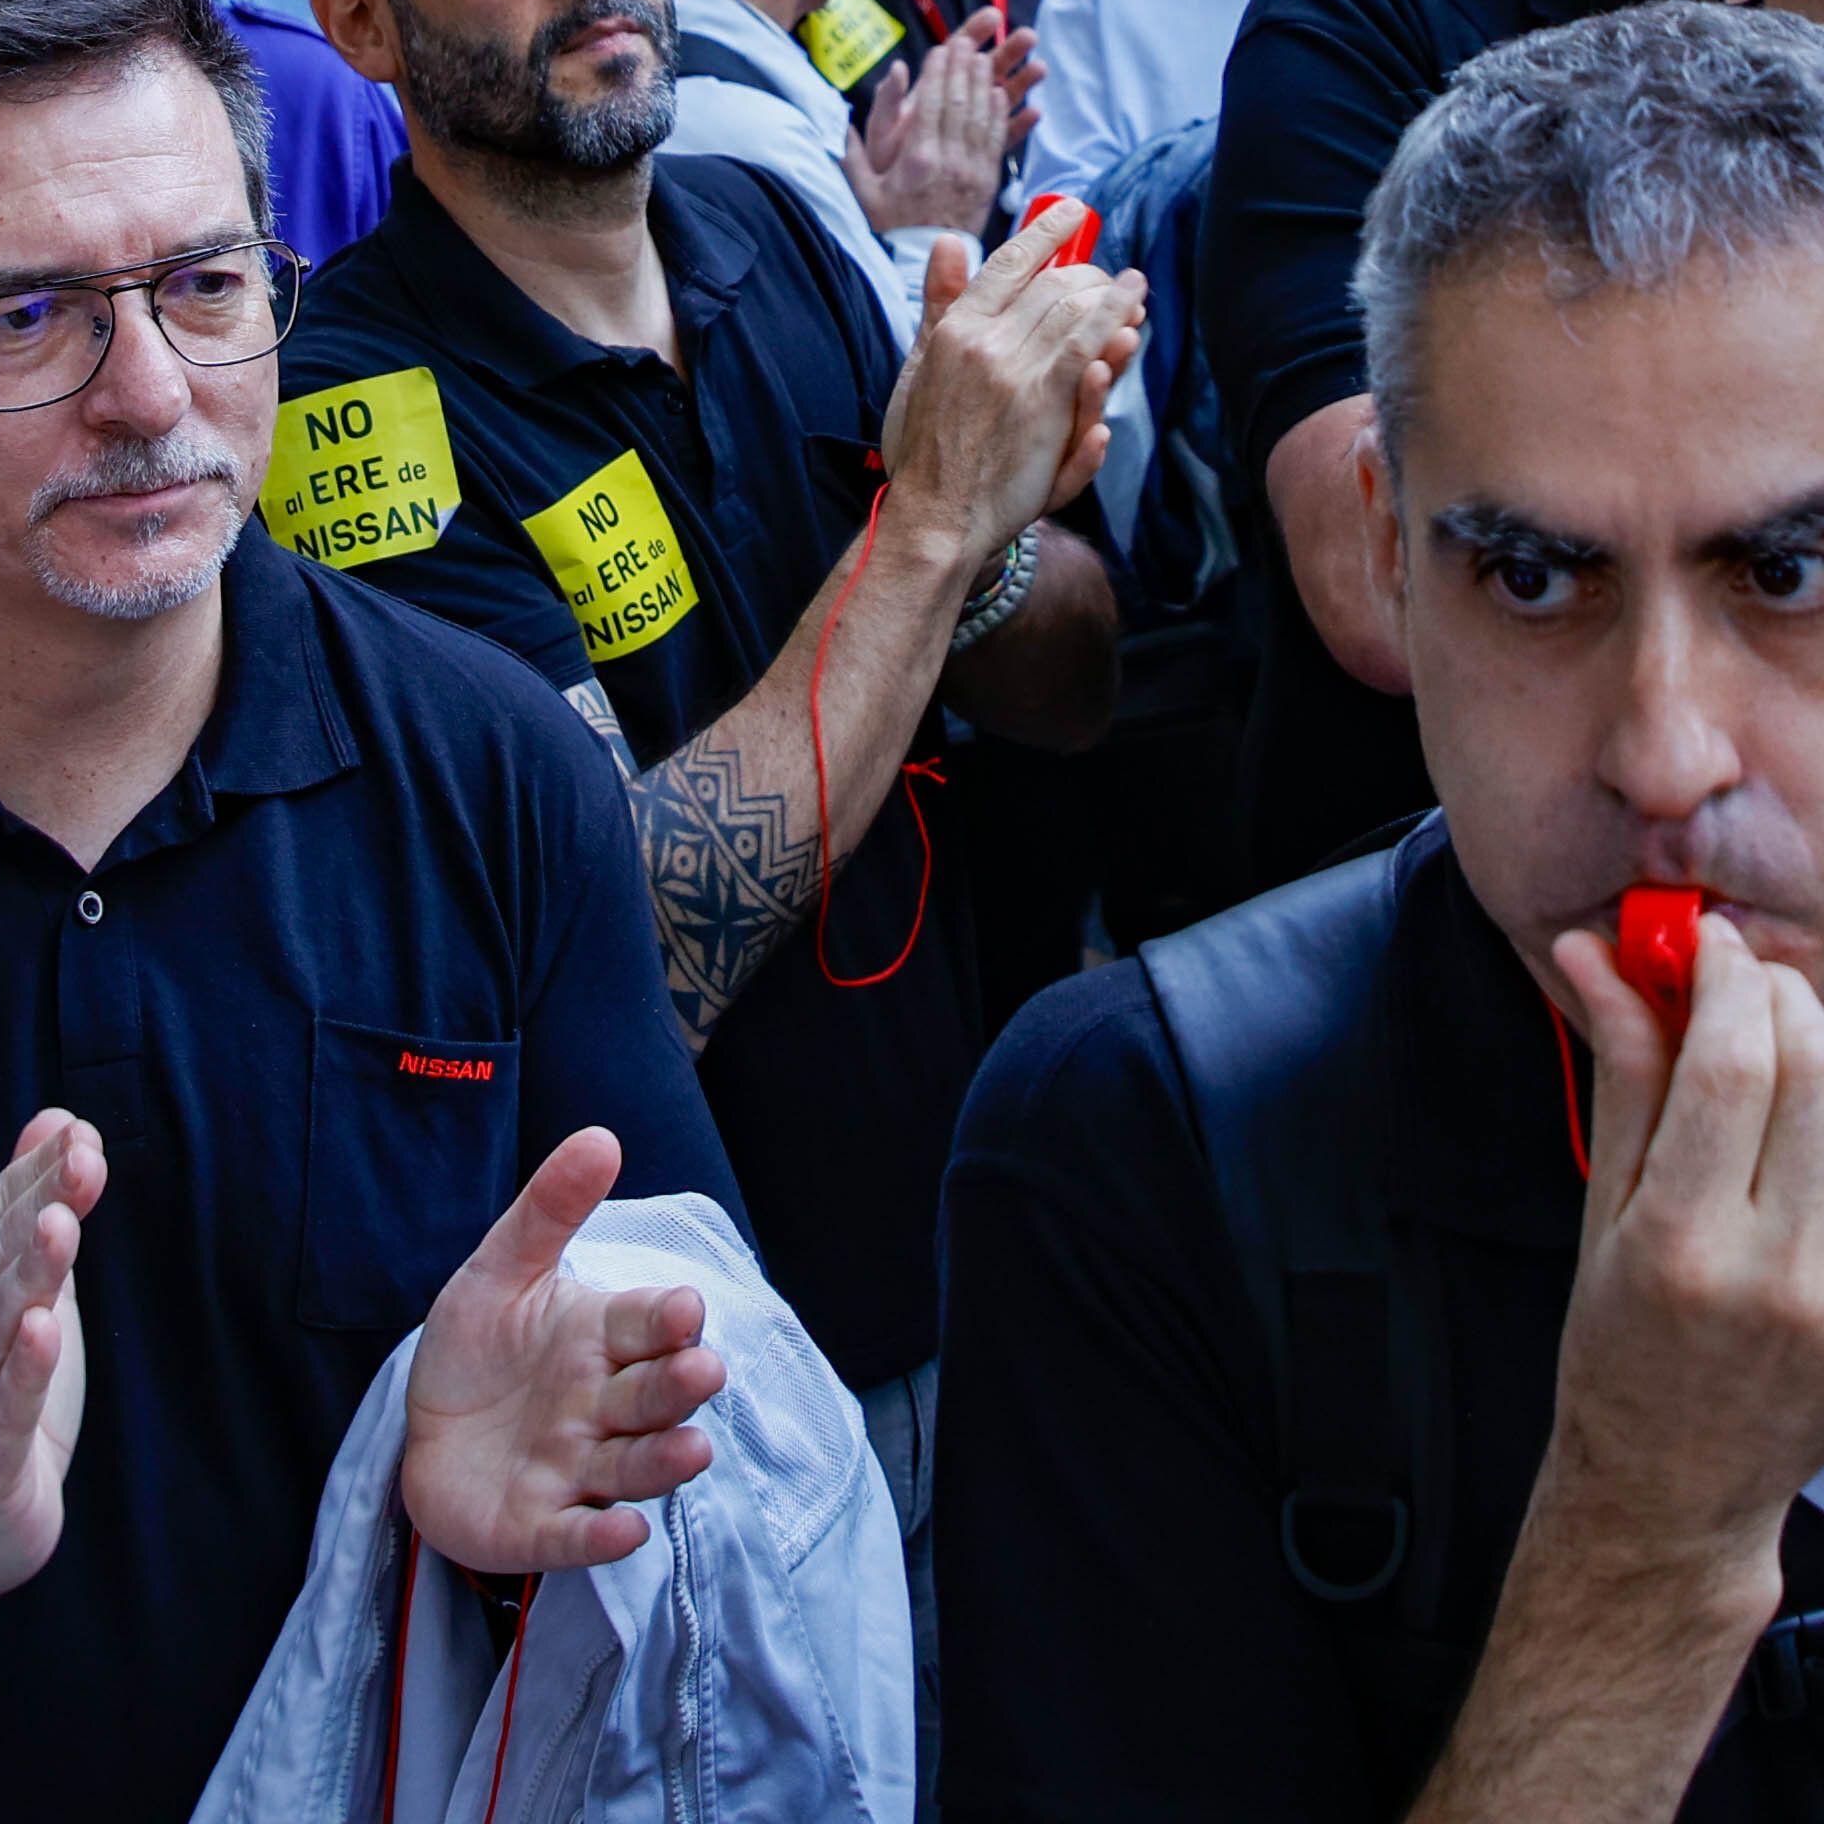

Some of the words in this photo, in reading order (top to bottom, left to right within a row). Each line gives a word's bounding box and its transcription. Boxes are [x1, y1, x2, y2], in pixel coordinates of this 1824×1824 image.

[305, 398, 374, 452] NO
[285, 491, 304, 516] al
[308, 455, 389, 507] ERE
[398, 461, 428, 485] de
[294, 497, 440, 560] NISSAN
[577, 492, 620, 543] NO
[574, 582, 596, 608] al
[598, 540, 649, 594] ERE
[647, 536, 667, 561] de
[582, 569, 685, 652] NISSAN
[399, 1051, 494, 1081] NISSAN
